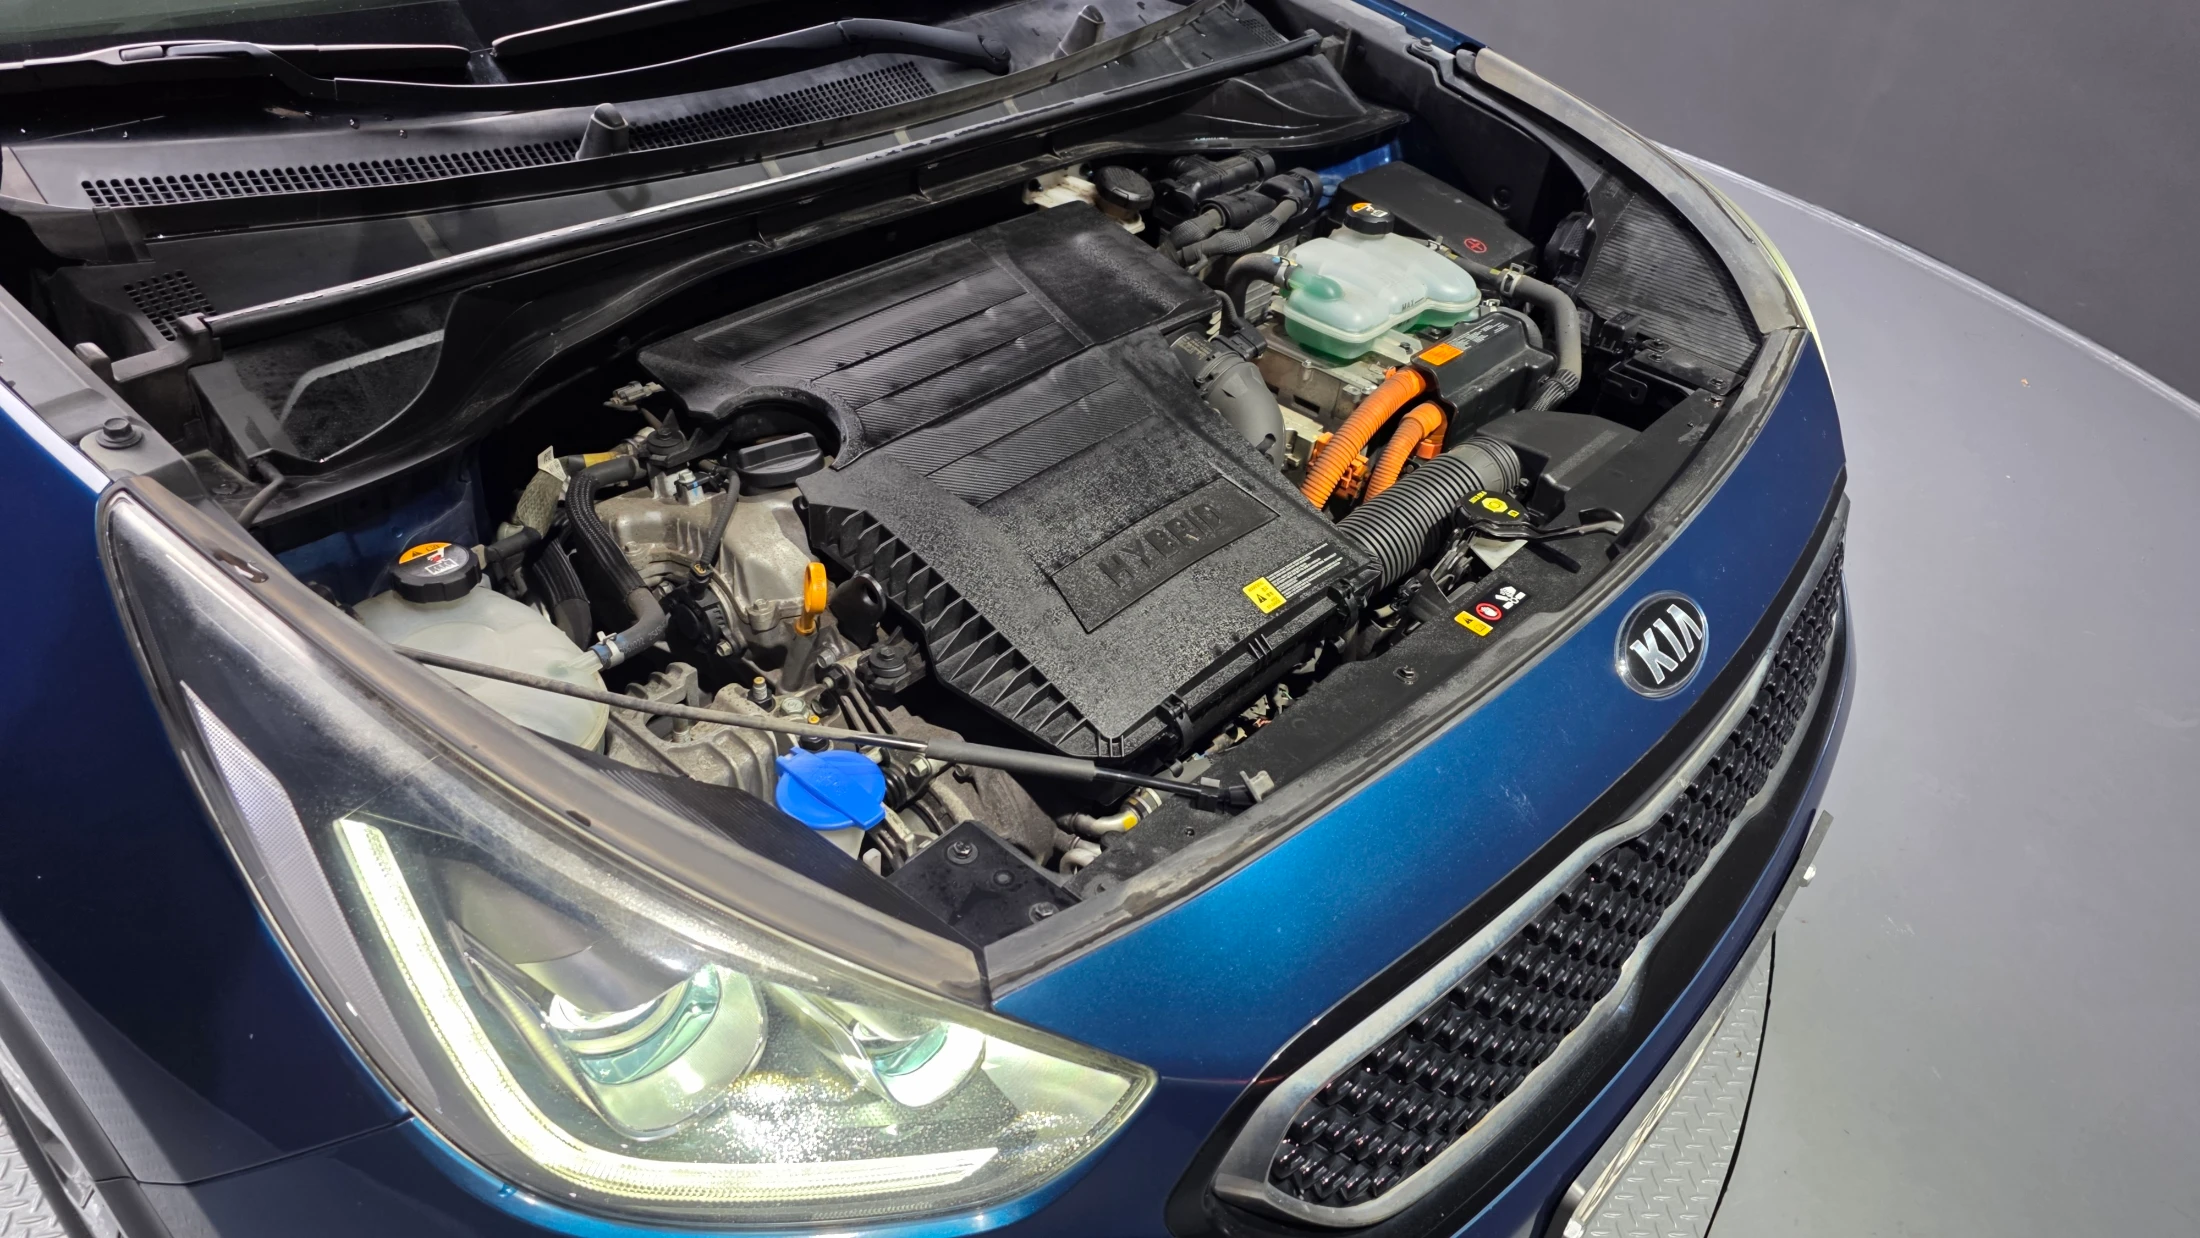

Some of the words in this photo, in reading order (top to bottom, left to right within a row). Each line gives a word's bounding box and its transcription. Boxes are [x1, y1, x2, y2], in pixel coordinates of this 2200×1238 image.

[1401, 299, 1414, 311] MAX
[1097, 503, 1222, 588] HYBRID
[1629, 603, 1703, 685] KIA
